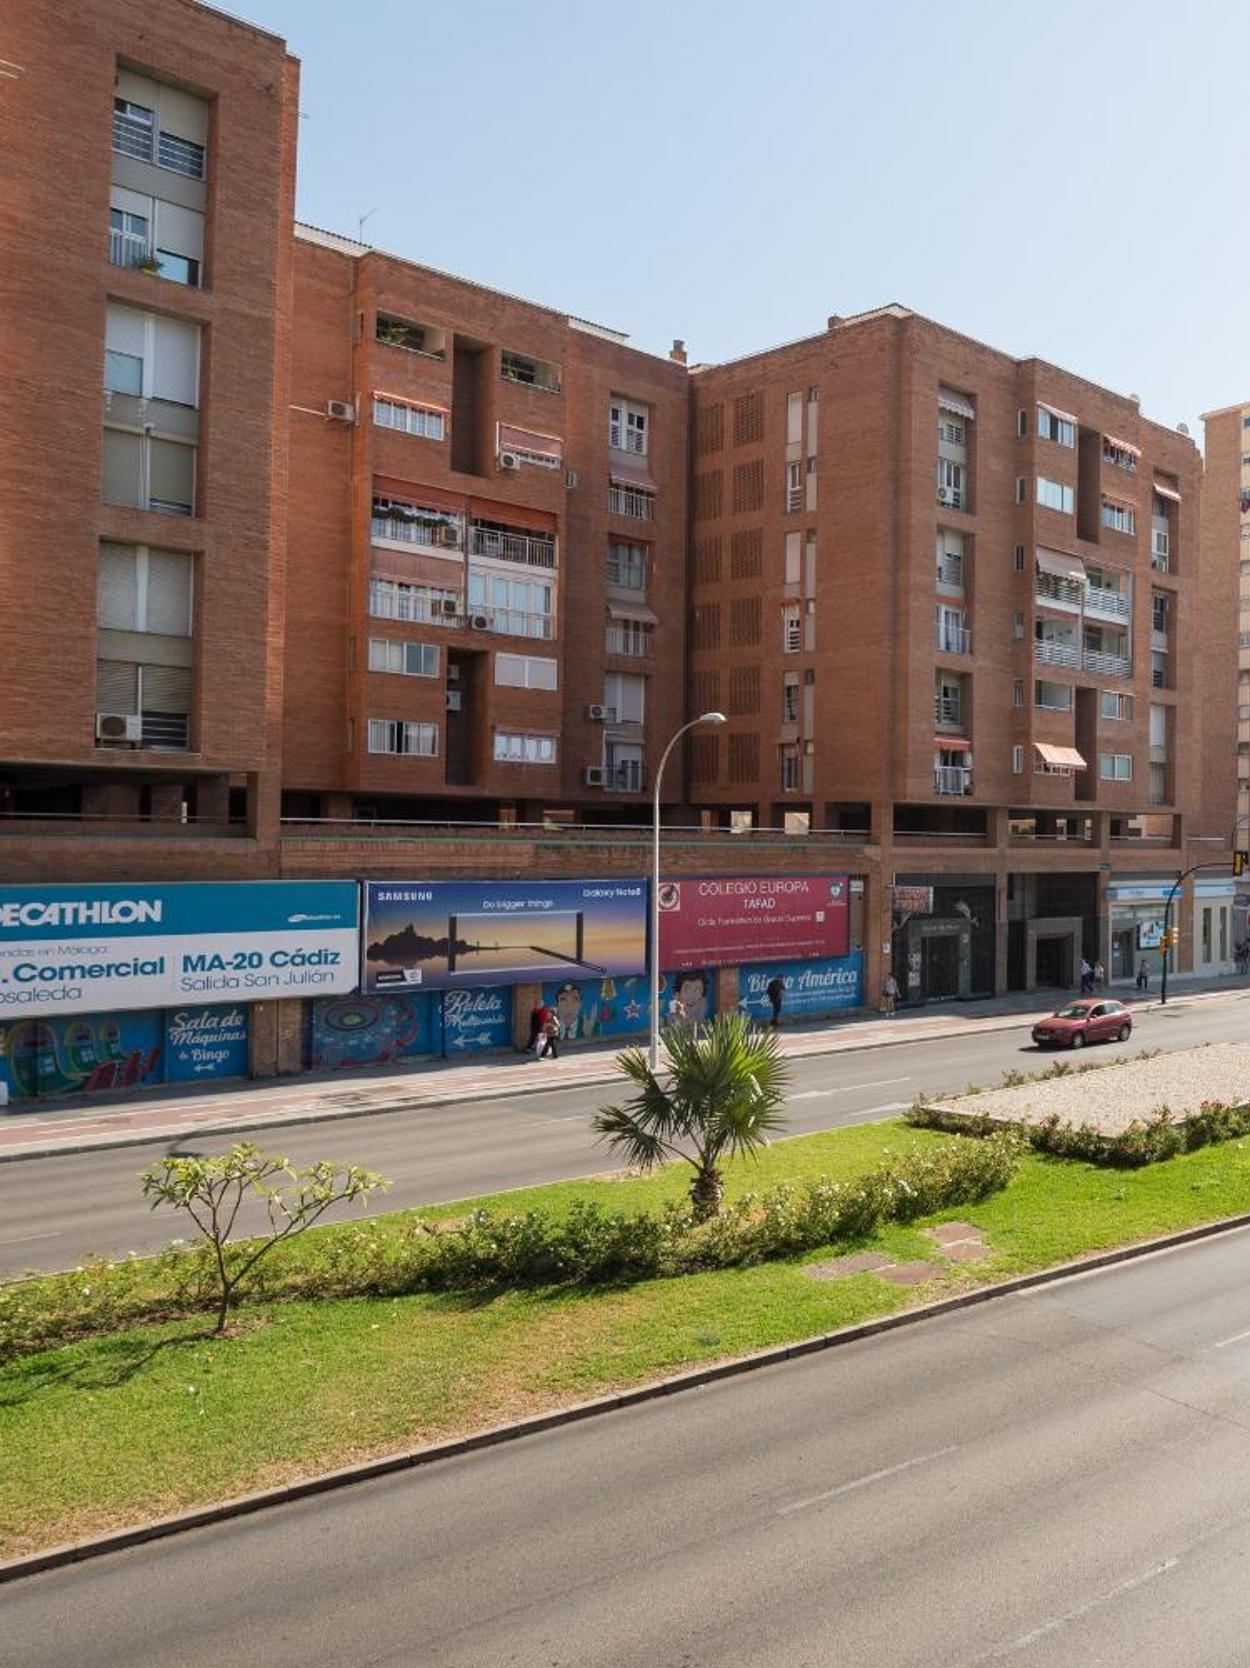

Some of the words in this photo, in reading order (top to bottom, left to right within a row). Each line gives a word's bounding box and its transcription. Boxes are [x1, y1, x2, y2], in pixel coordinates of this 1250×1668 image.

[378, 891, 432, 901] SAMSUNG
[699, 882, 756, 896] COLEGIO
[759, 881, 809, 894] EUROPA
[0, 900, 162, 927] ECATHLON
[13, 956, 165, 982] Comercial
[183, 952, 262, 973] MA-20
[269, 949, 341, 967] Cádiz
[181, 977, 239, 992] Salida
[244, 973, 278, 987] San
[284, 970, 334, 986] Julián
[799, 967, 857, 990] América
[170, 1011, 219, 1033] Sala
[191, 1048, 230, 1063] Bingo
